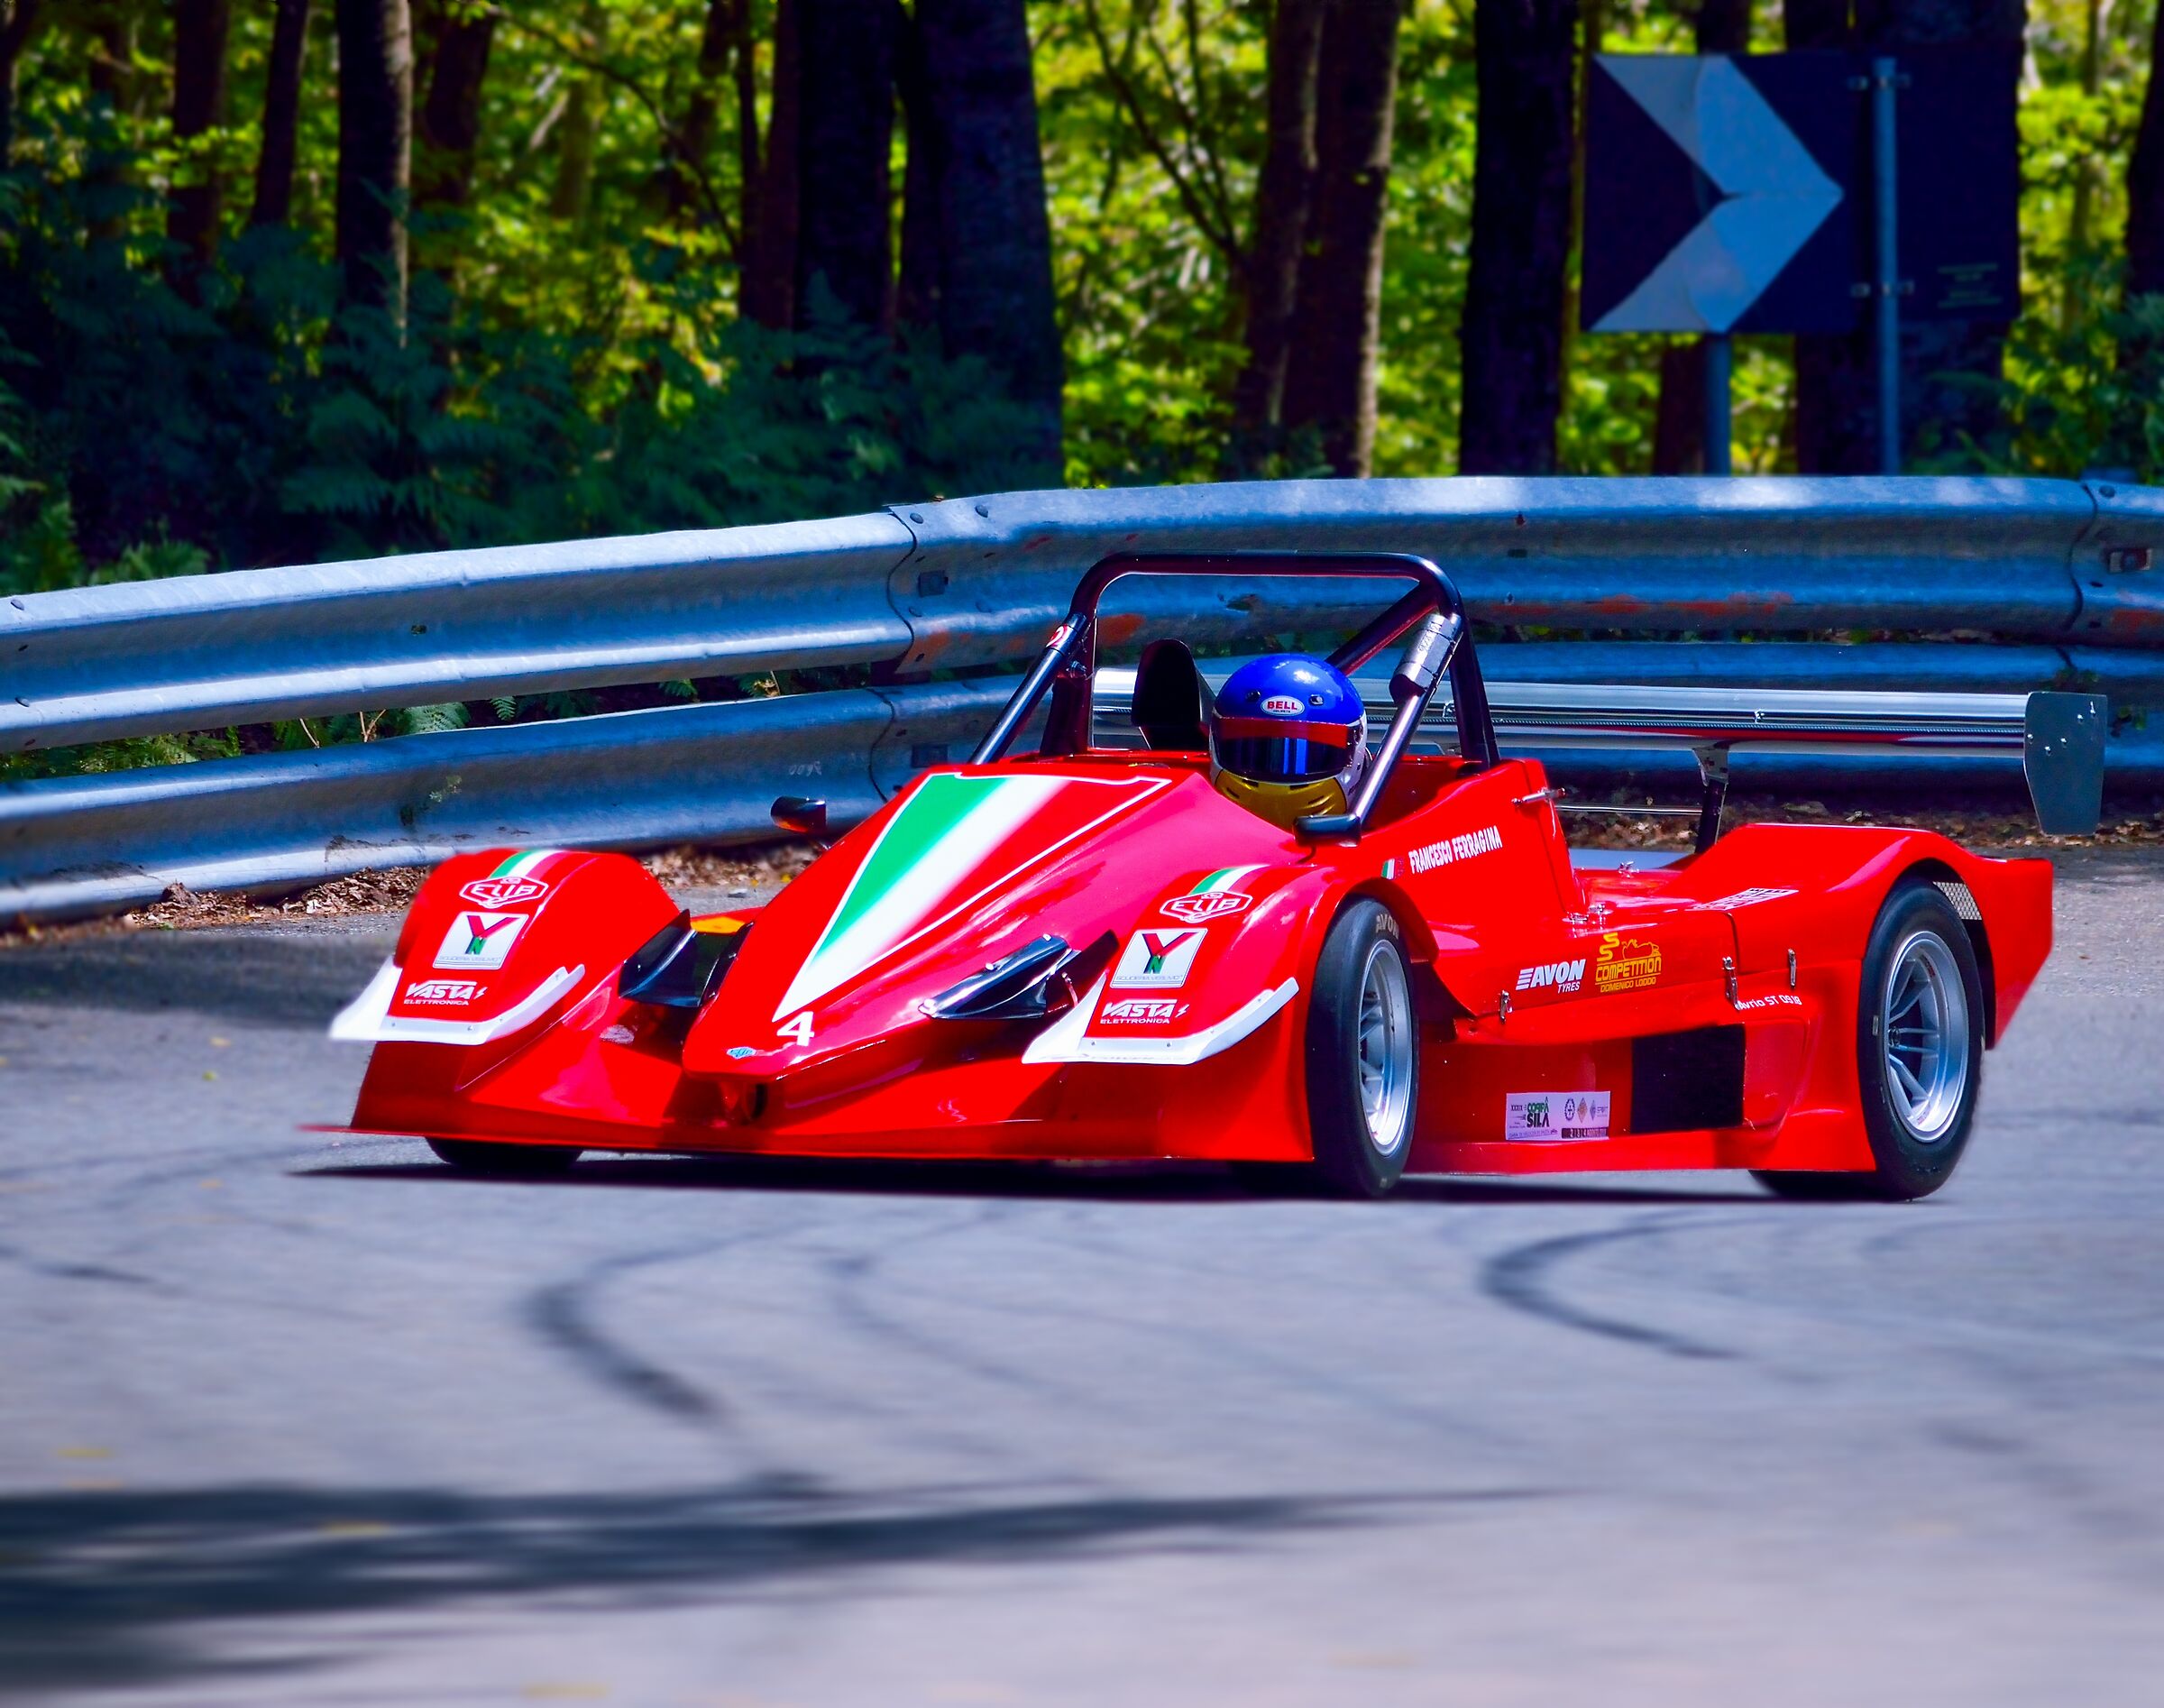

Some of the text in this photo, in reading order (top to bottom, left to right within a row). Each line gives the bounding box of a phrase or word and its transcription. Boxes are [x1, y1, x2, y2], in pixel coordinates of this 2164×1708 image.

[1267, 701, 1297, 711] BELL
[1408, 825, 1503, 874] FRANCESCO FERRAGINA
[1530, 959, 1586, 987] AVON
[1595, 956, 1662, 982] COMPETITION
[405, 980, 477, 999] VASTA
[1557, 982, 1581, 994] TYRES
[1600, 980, 1634, 993] DOMENICO
[1102, 999, 1178, 1017] VASTA
[1764, 995, 1779, 1006] ST
[776, 1011, 815, 1046] 4
[1527, 1113, 1550, 1127] SILA
